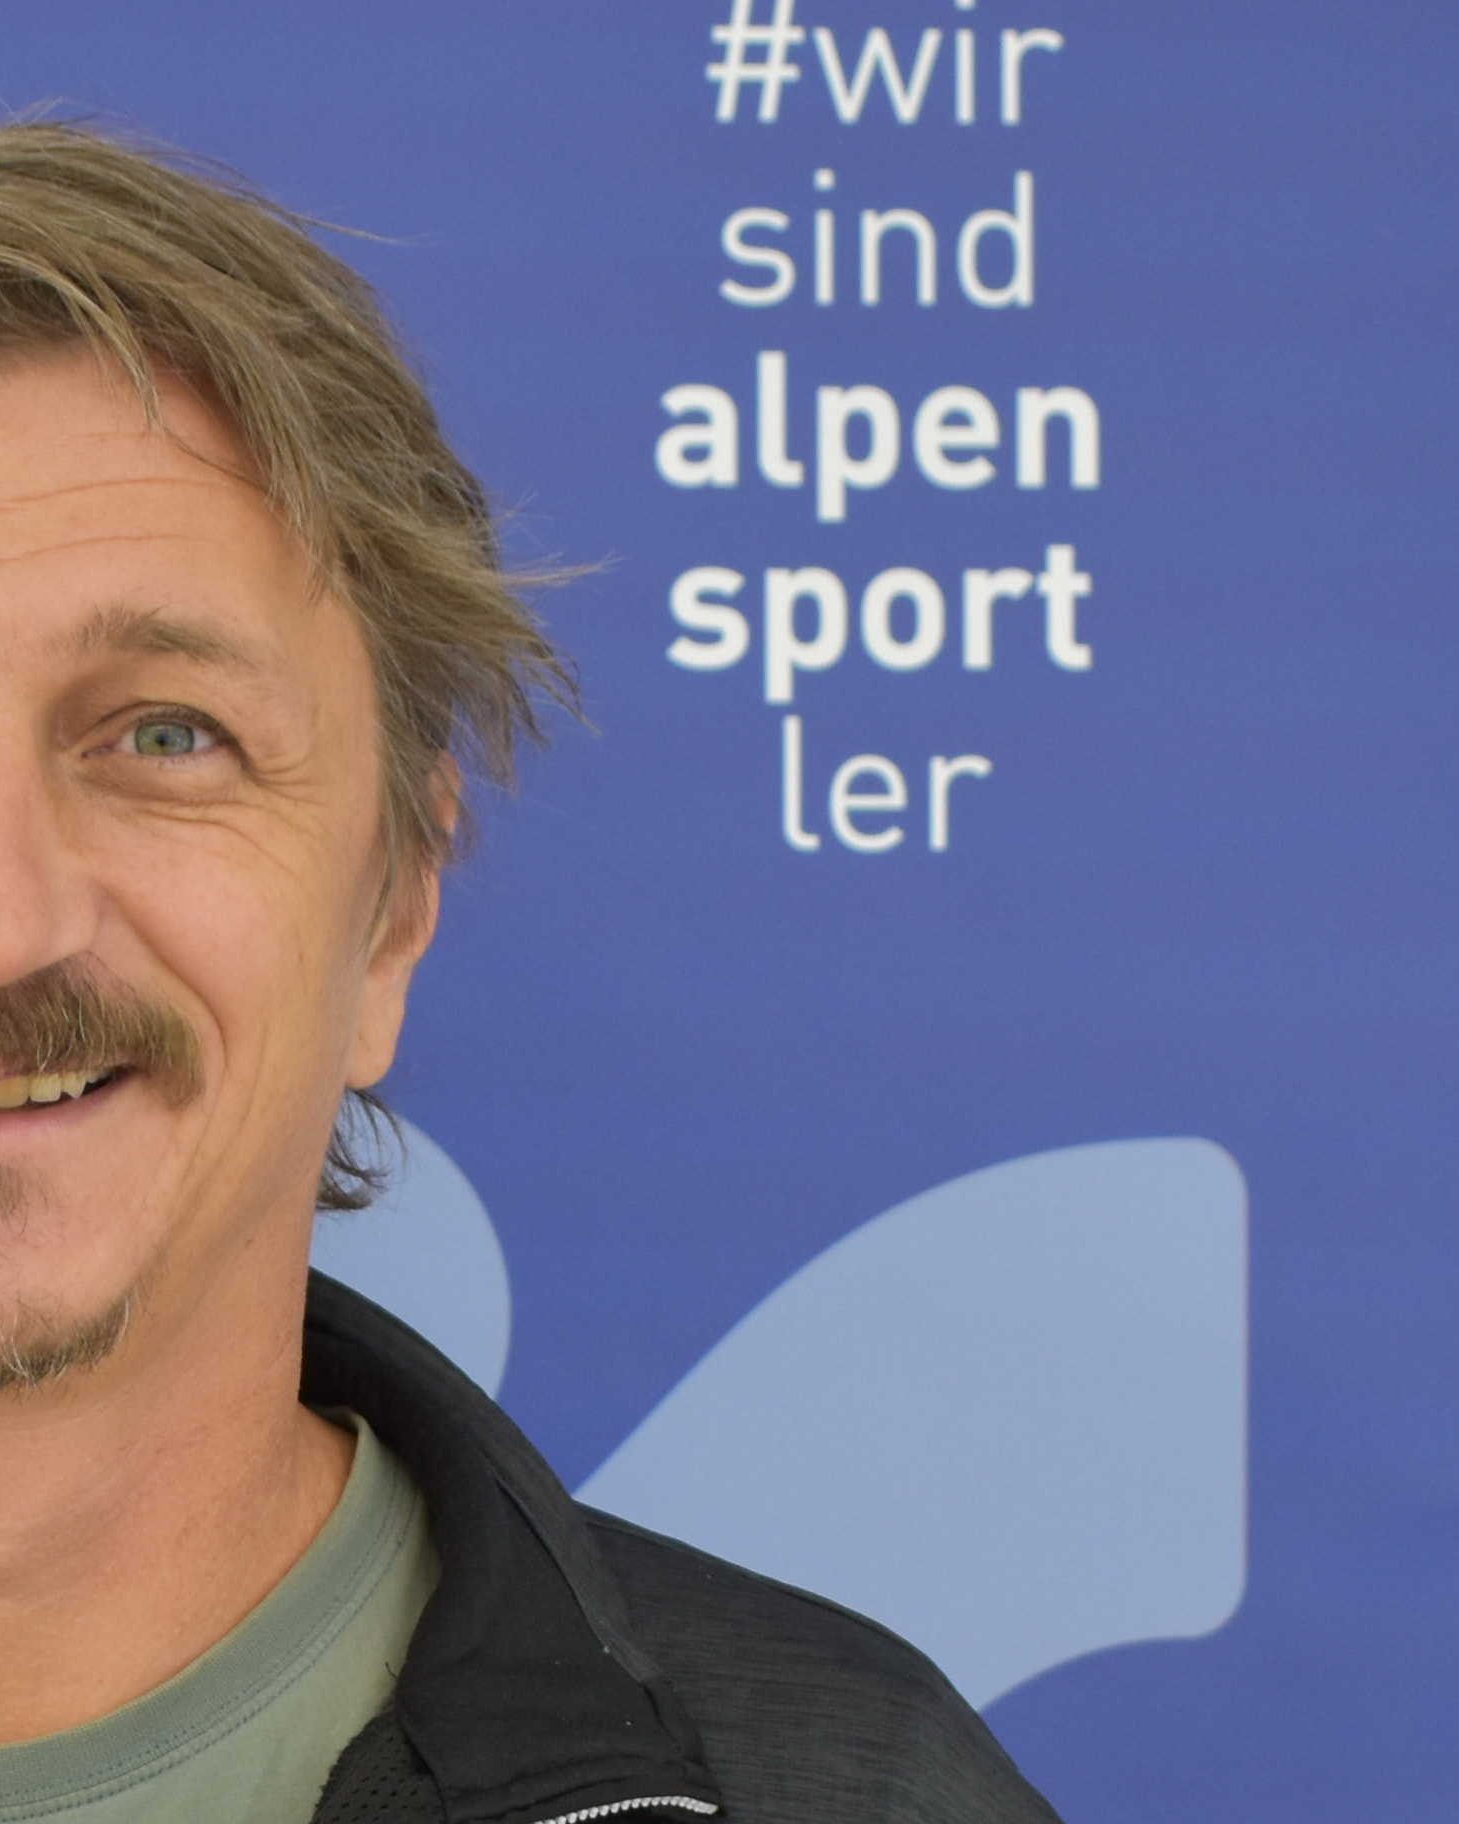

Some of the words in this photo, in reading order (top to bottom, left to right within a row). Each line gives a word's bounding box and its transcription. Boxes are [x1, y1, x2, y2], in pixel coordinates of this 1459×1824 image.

[706, 0, 1063, 125] #wir
[720, 167, 1034, 308] sind
[655, 349, 1101, 522] alpen
[667, 543, 1093, 704] sport
[783, 714, 993, 852] ler
